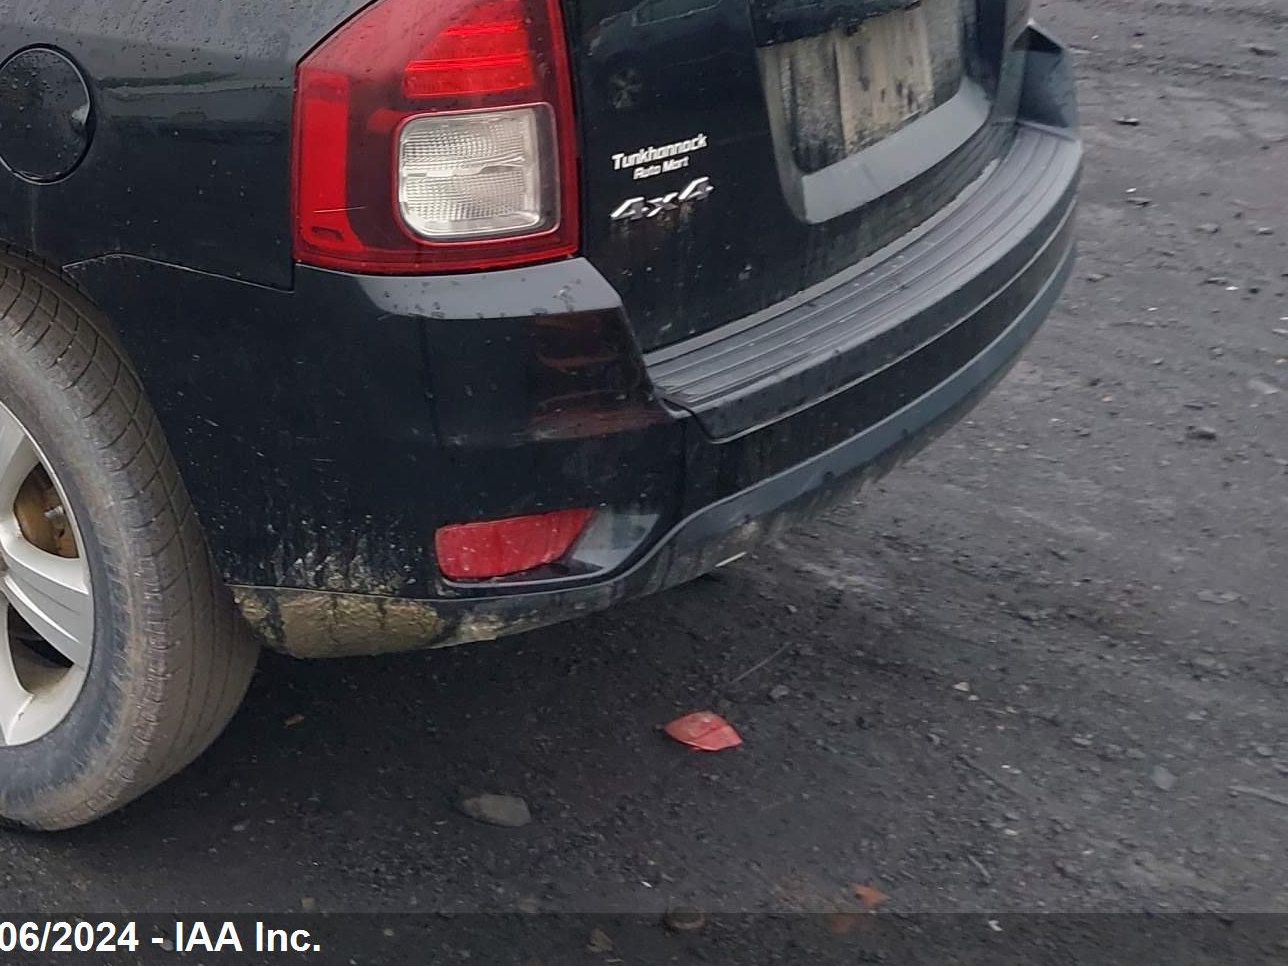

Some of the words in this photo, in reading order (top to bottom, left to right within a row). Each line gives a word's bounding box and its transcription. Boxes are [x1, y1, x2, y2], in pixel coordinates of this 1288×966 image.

[611, 133, 708, 170] Tunkhannock
[633, 164, 662, 180] Auto
[662, 155, 690, 173] Mart
[610, 176, 715, 221] 4x4
